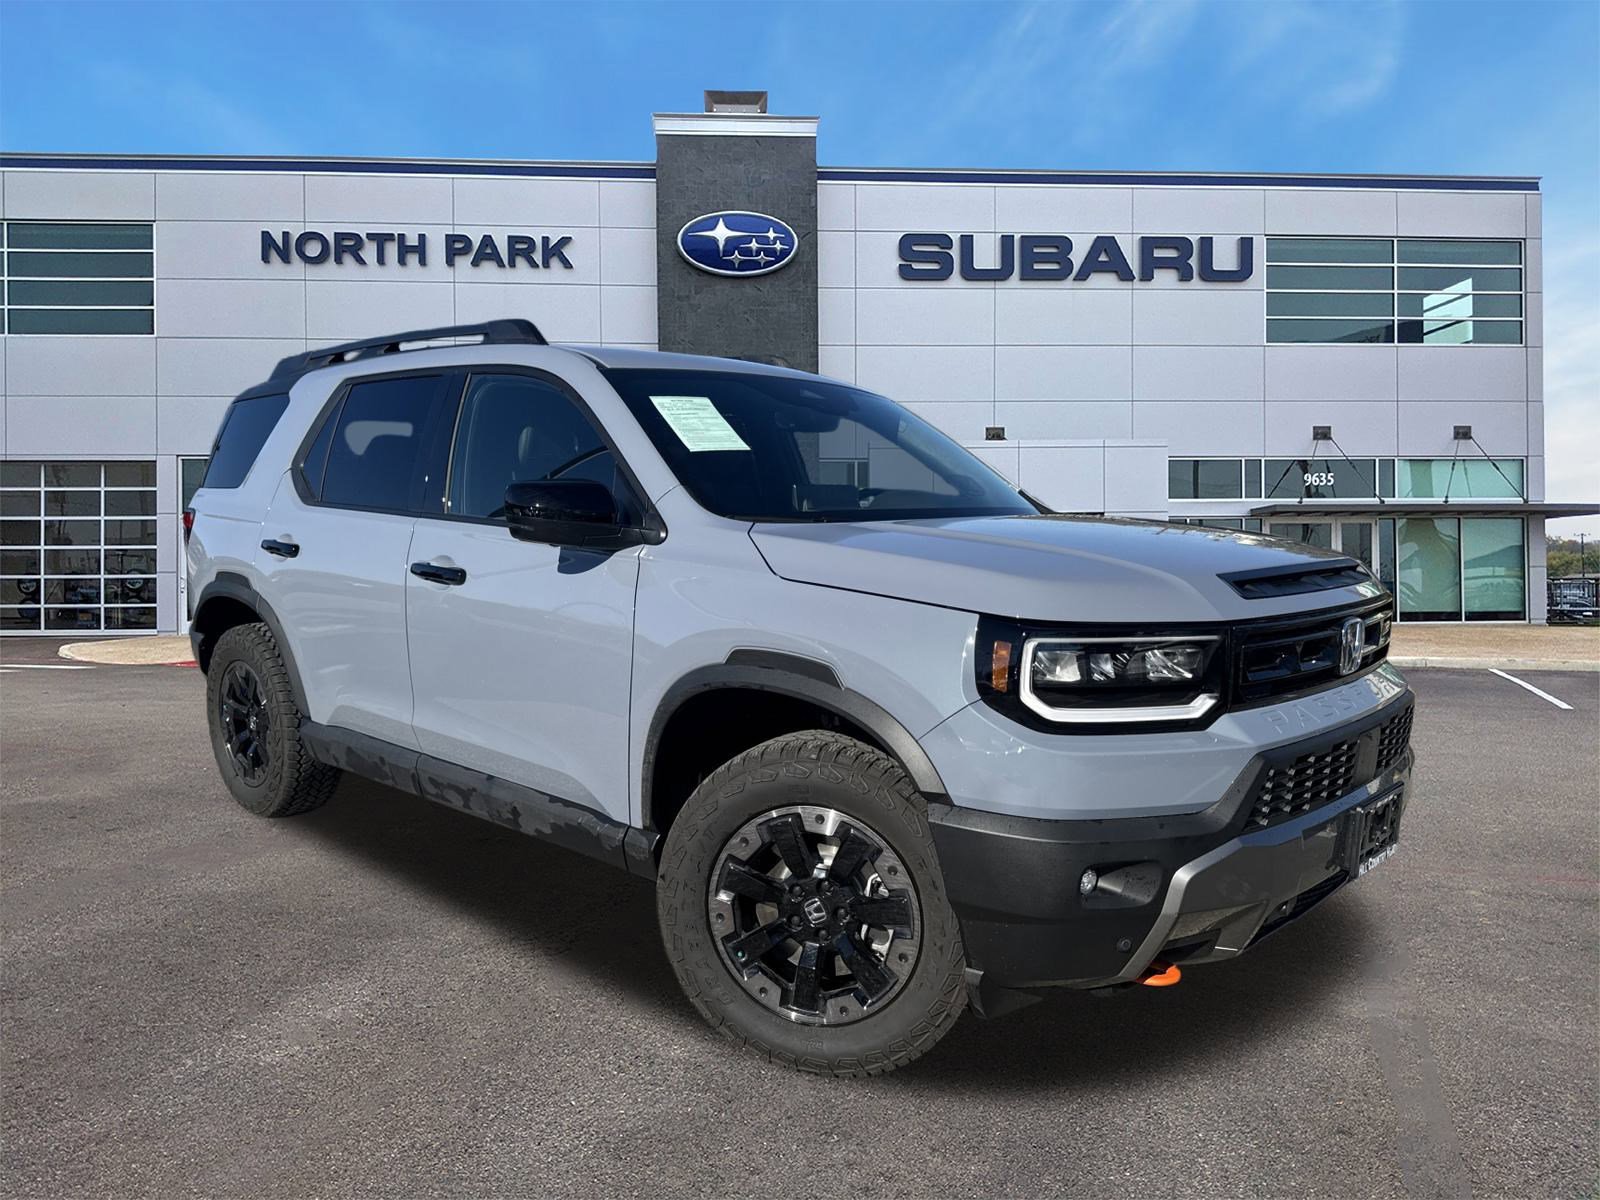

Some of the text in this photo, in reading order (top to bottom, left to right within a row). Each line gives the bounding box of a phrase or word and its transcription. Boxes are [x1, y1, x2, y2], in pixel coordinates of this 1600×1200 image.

[260, 230, 574, 269] NORTH PARK
[898, 233, 1254, 282] SUBARU
[1303, 472, 1335, 486] 9635
